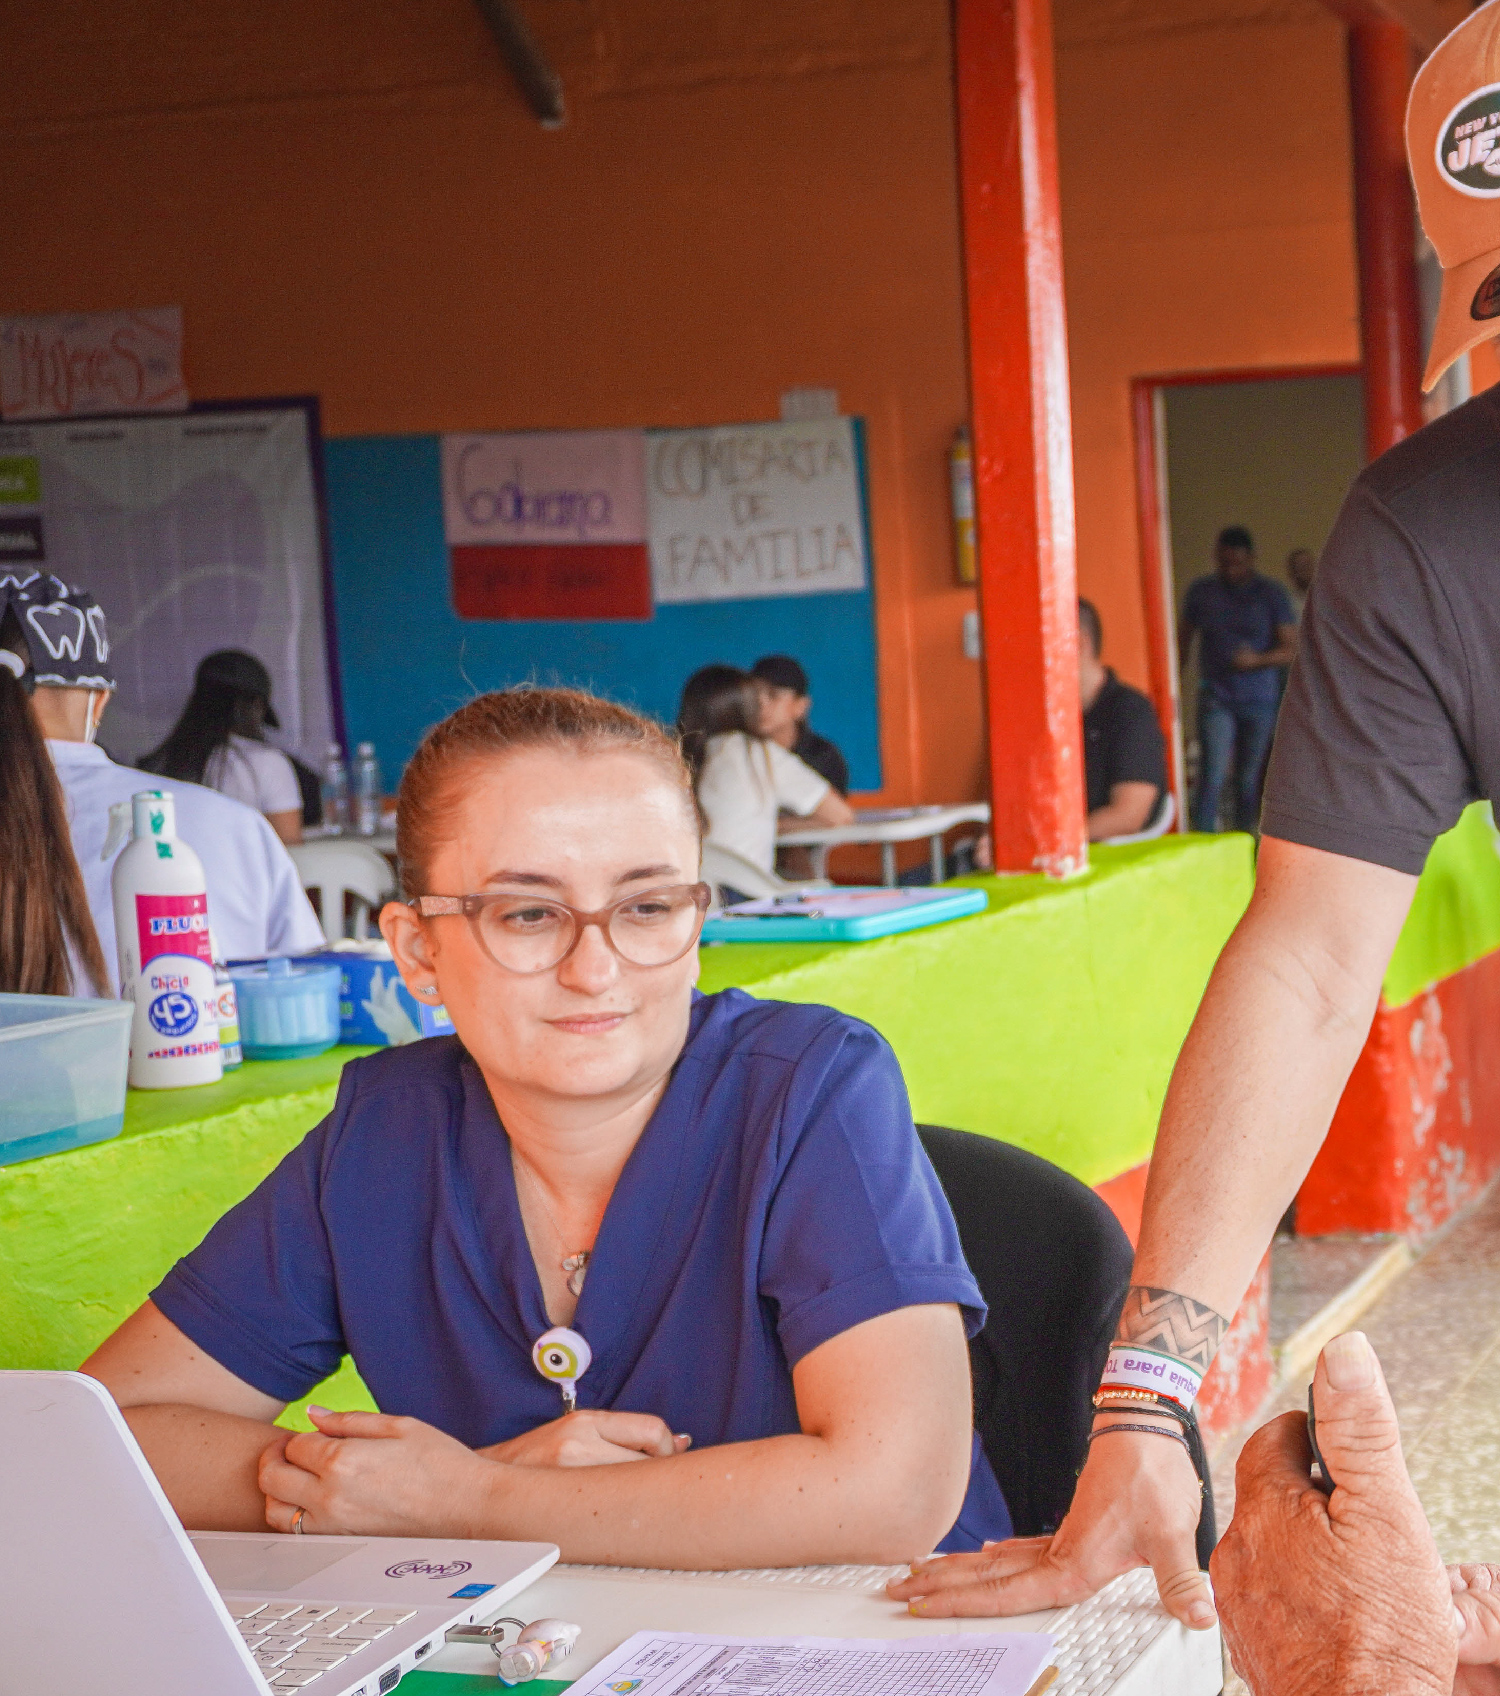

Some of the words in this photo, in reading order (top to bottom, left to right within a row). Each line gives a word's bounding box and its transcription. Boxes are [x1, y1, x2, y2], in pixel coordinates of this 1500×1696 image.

[1454, 116, 1488, 139] NEW
[730, 492, 772, 527] DE
[668, 522, 859, 589] FAMILIA
[153, 995, 192, 1026] 45
[1124, 1358, 1167, 1378] para
